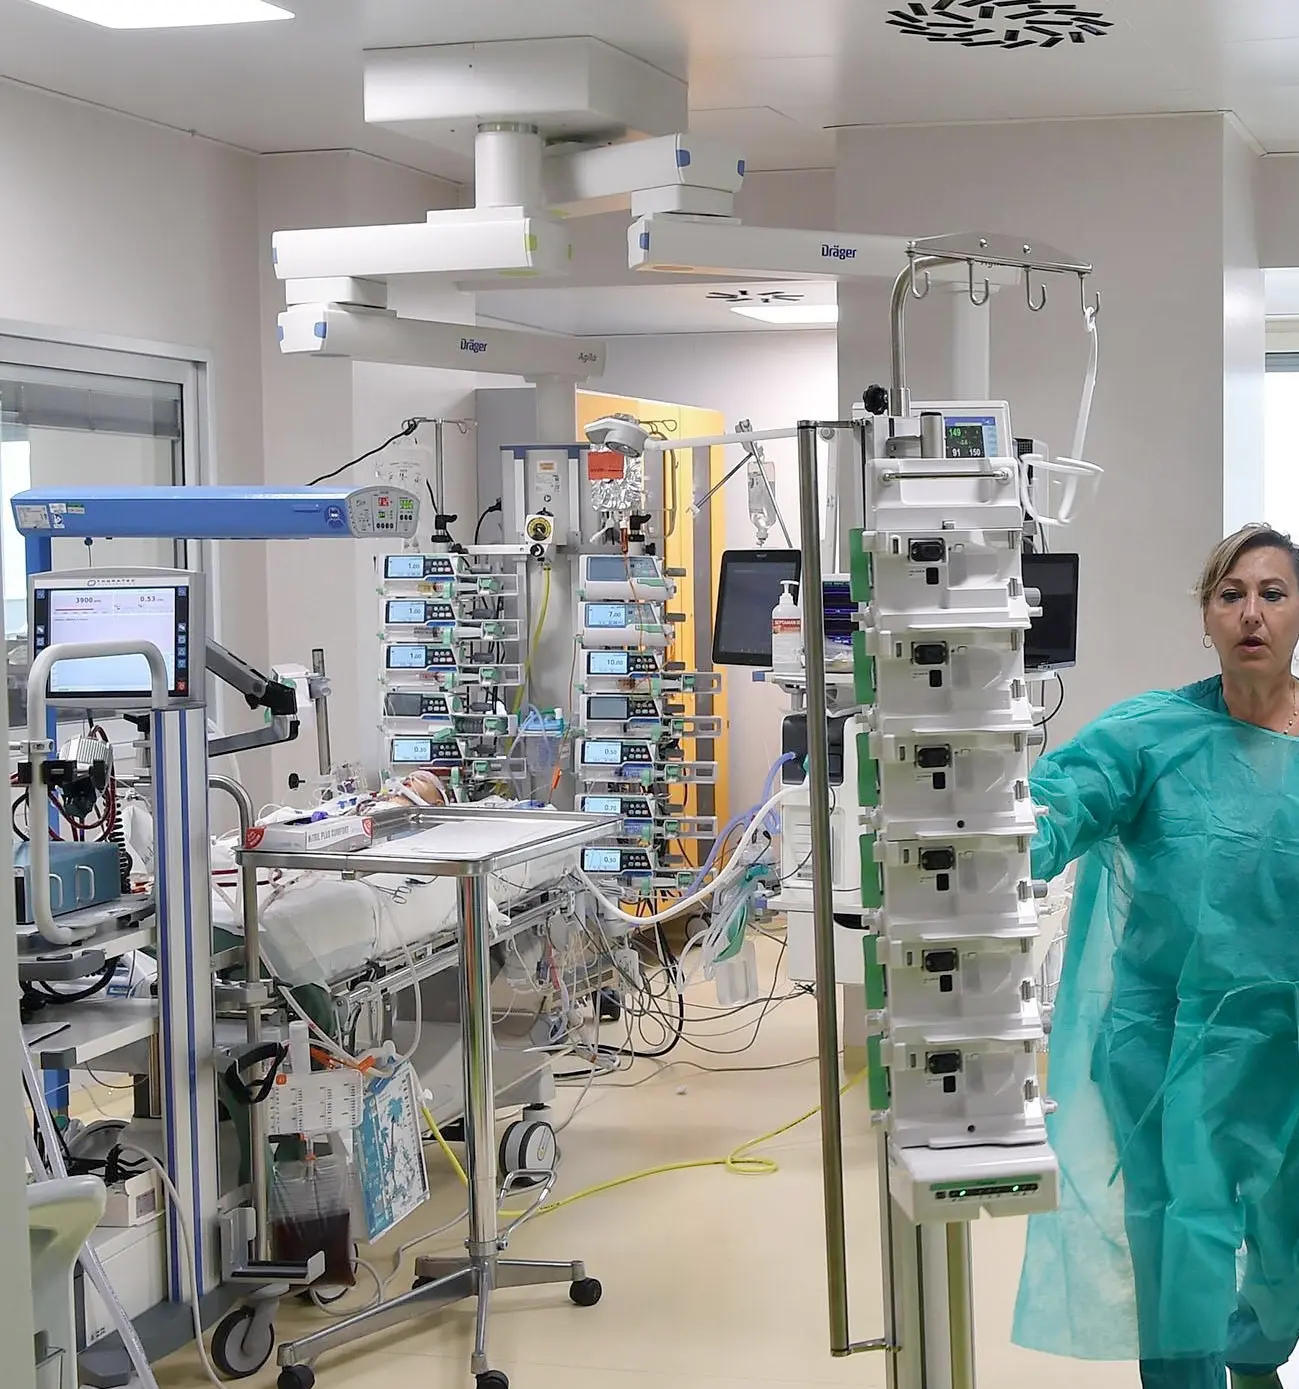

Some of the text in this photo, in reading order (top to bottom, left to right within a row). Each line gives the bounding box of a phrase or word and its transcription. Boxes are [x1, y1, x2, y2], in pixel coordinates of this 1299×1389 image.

[821, 244, 858, 260] Dräger
[460, 337, 488, 354] Dräger
[948, 427, 962, 437] 149
[951, 448, 981, 457] 91 150
